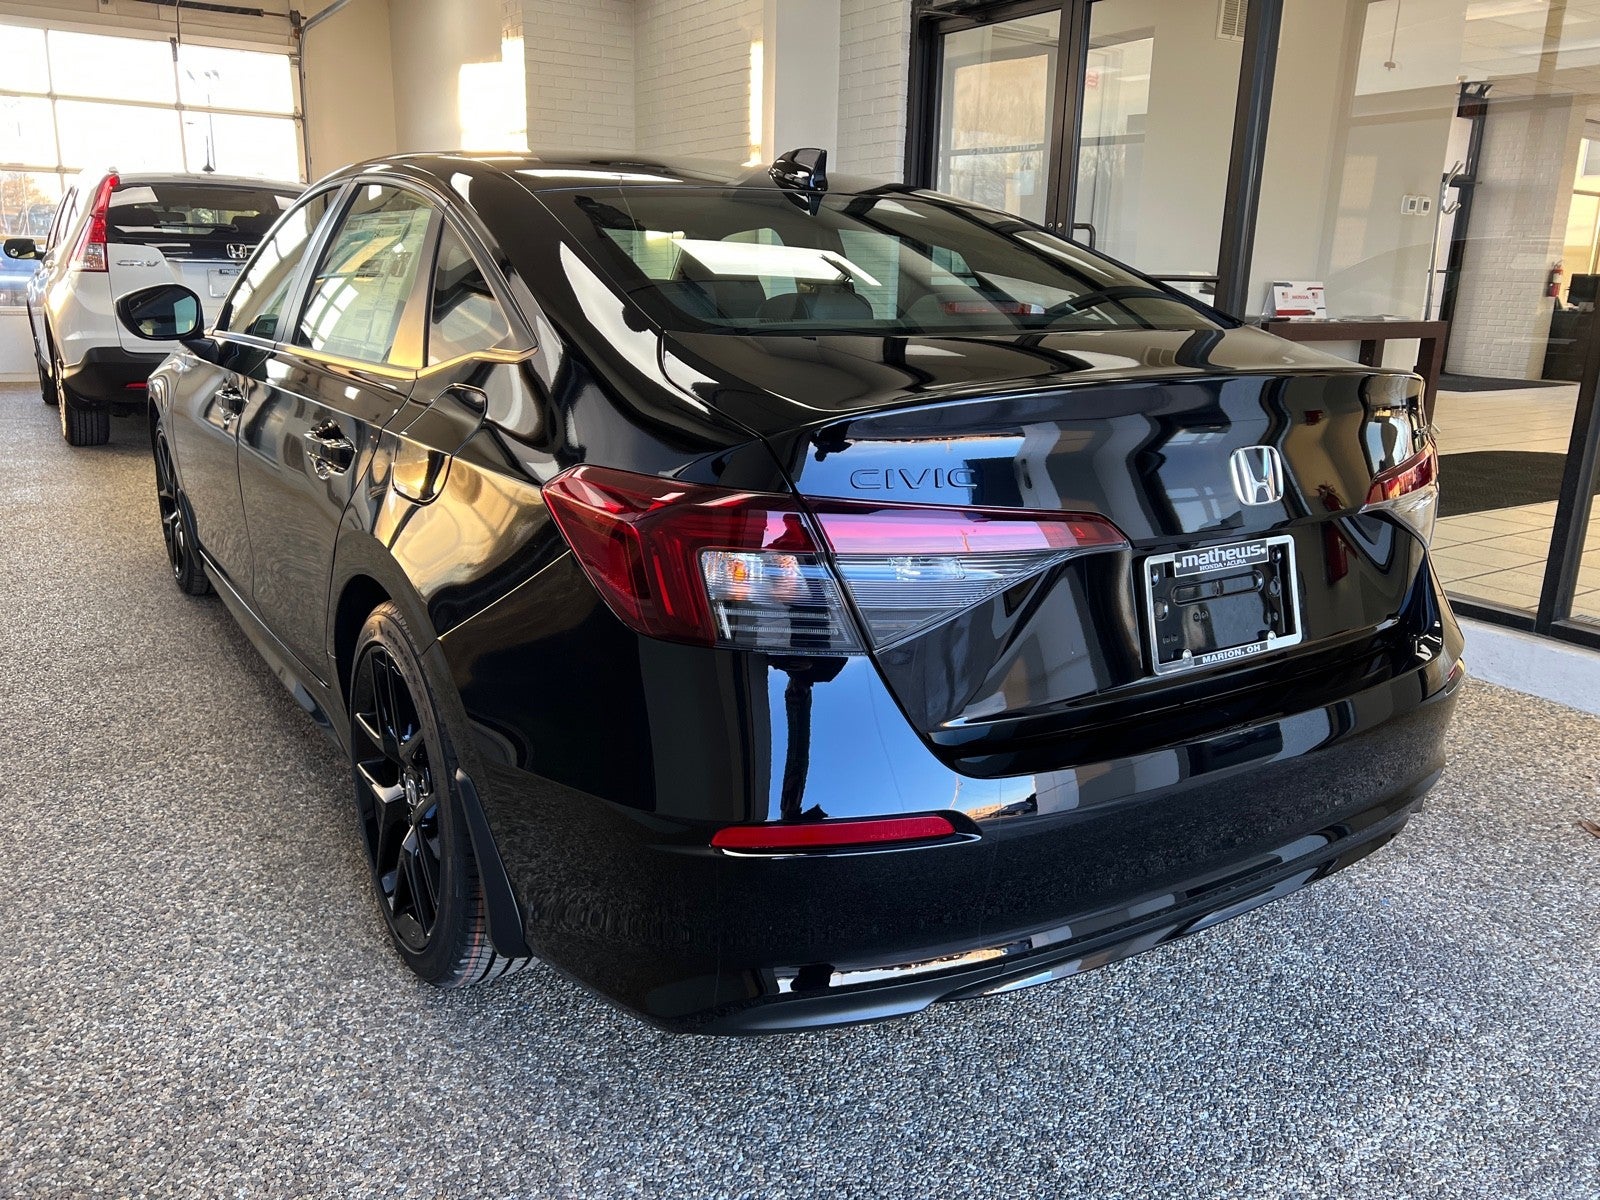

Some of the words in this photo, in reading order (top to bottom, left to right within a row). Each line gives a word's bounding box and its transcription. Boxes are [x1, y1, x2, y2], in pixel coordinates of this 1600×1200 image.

[850, 467, 978, 490] CIVIC
[1181, 544, 1261, 568] mathews
[1199, 562, 1223, 571] HONDA
[1226, 558, 1247, 567] ACURA
[1246, 644, 1261, 653] OH
